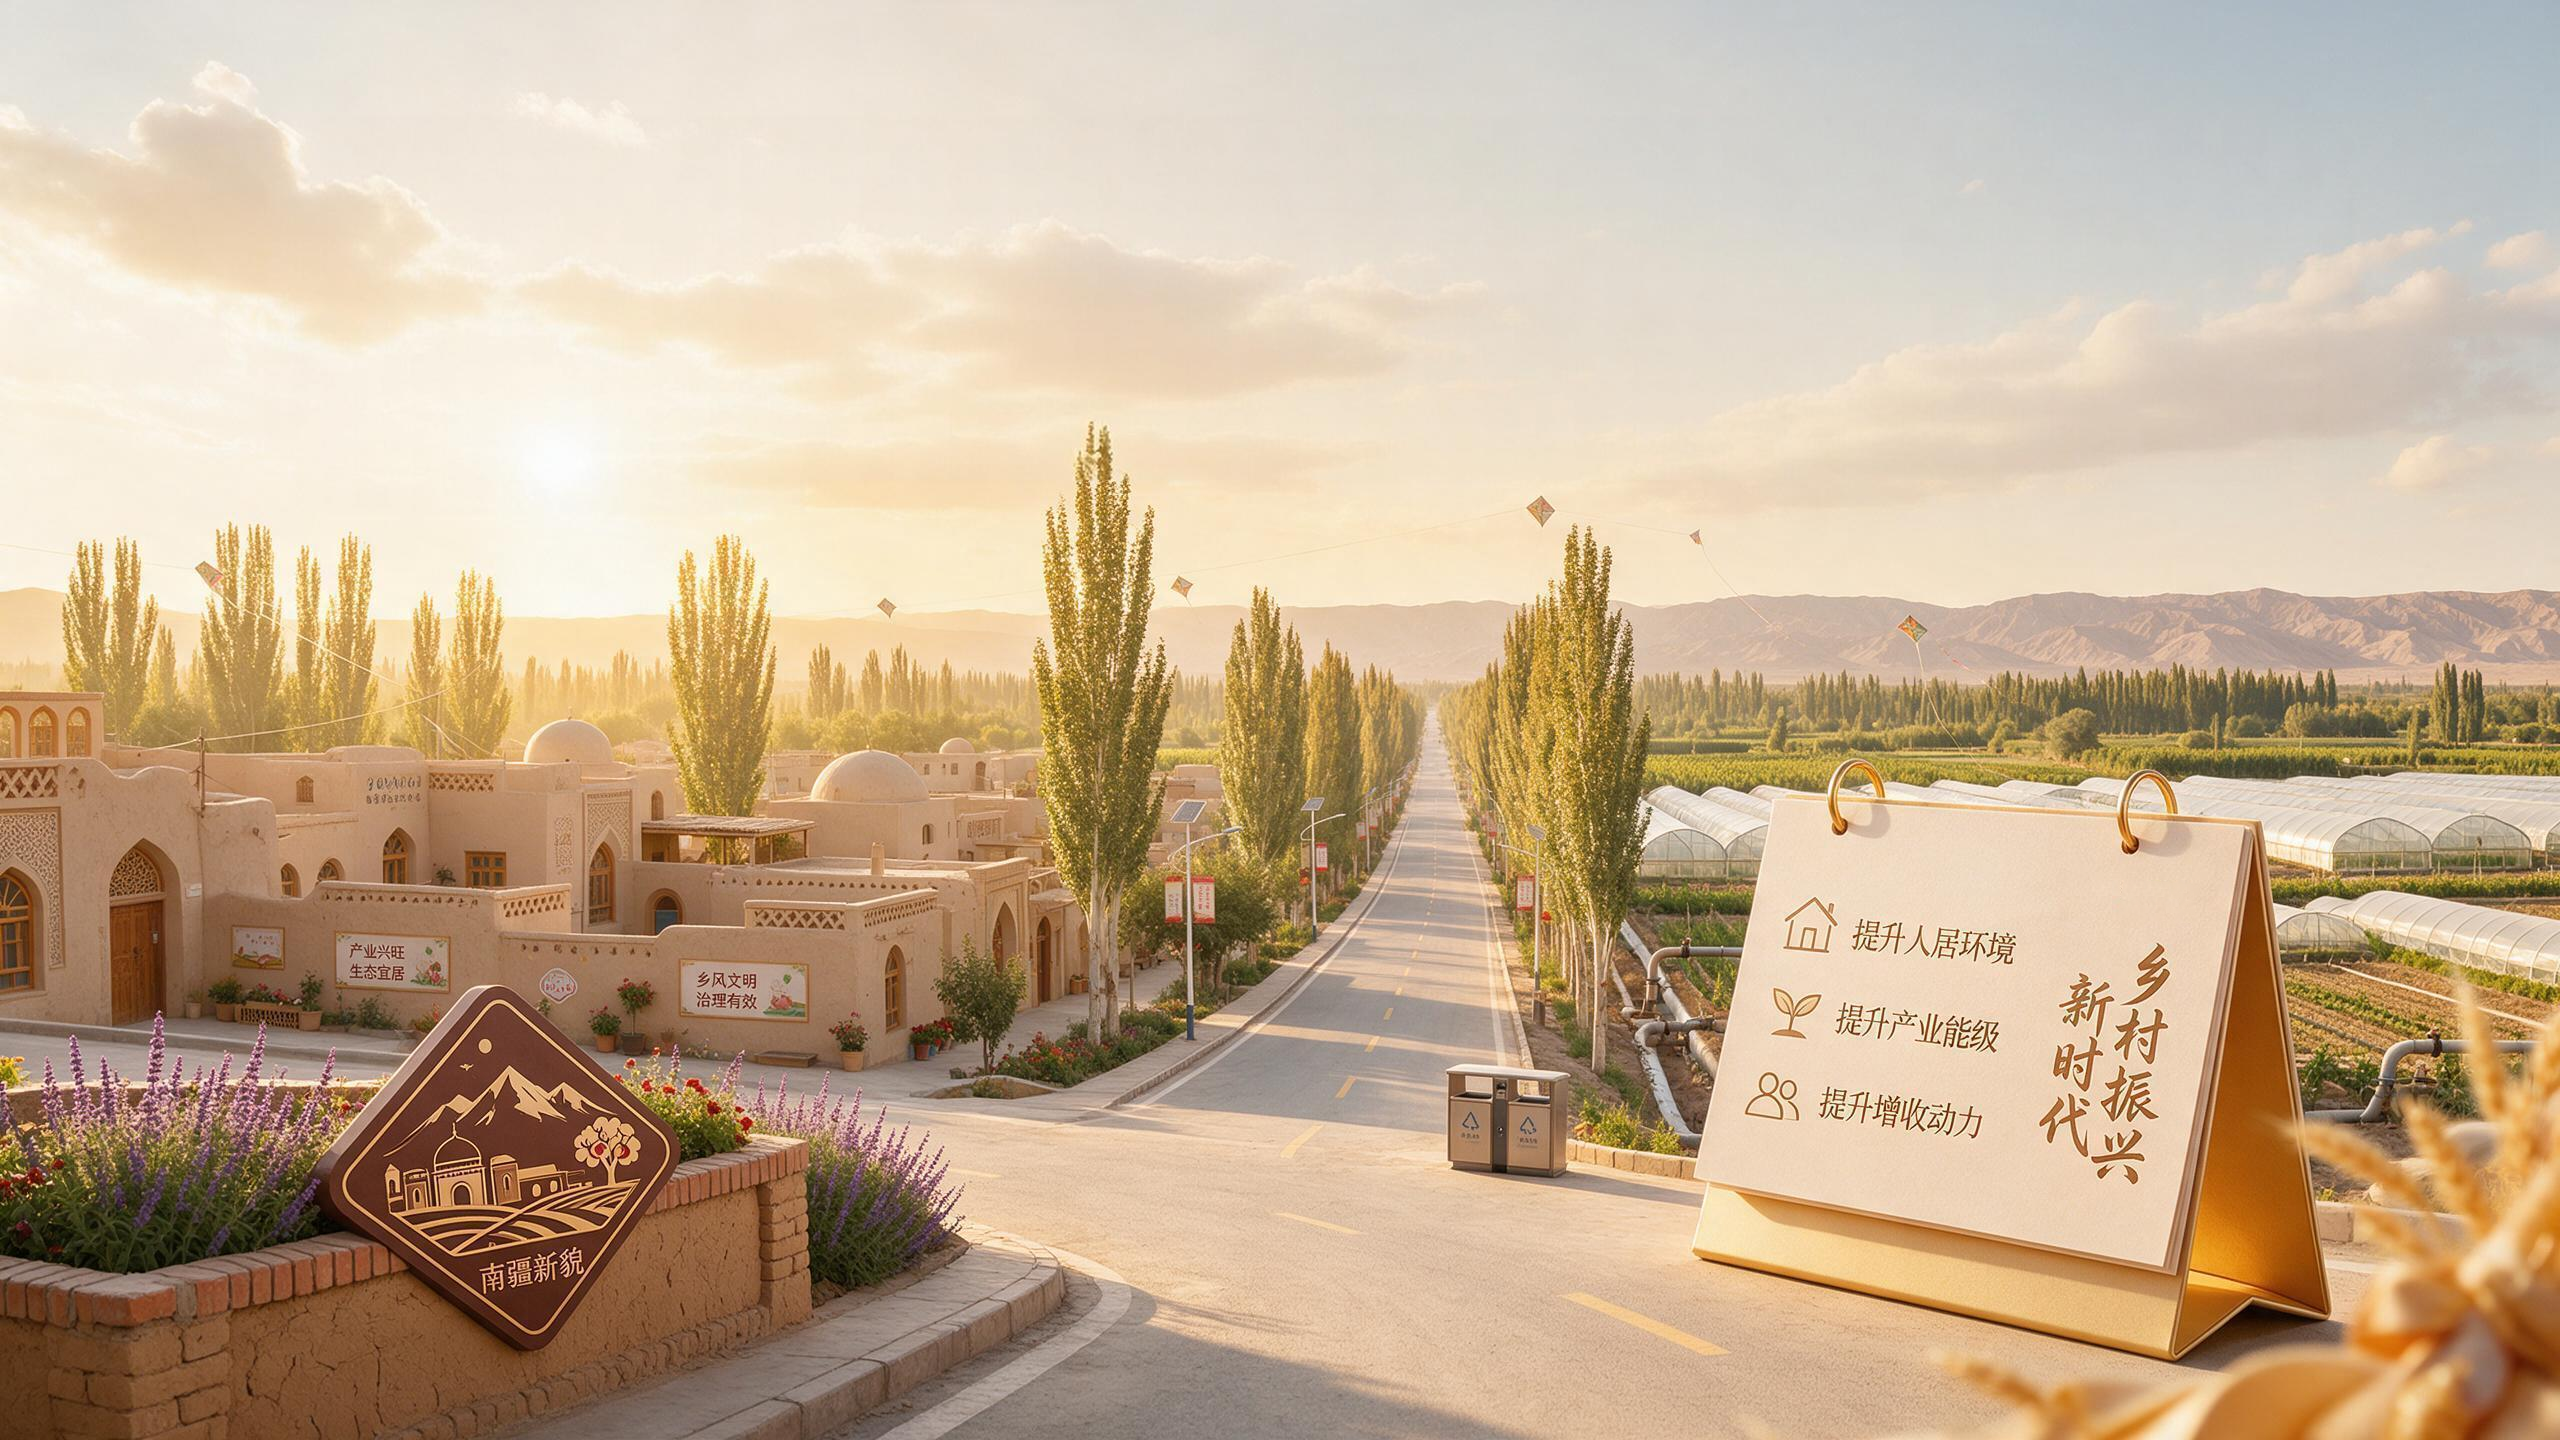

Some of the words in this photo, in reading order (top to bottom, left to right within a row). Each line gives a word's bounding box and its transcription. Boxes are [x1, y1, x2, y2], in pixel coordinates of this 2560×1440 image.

[350, 942, 405, 960] 产业兴旺
[1851, 918, 2017, 965] 提升人居环境
[350, 963, 405, 981] 生态宜居
[696, 972, 757, 989] 乡风文明
[696, 991, 757, 1010] 治理有效
[1835, 1002, 2000, 1054] 提升产业能级
[2038, 972, 2115, 1158] 新时代
[2091, 943, 2171, 1185] 乡村振兴
[1818, 1086, 1984, 1139] 提升增收动力
[479, 1246, 585, 1294] 南疆新貌
